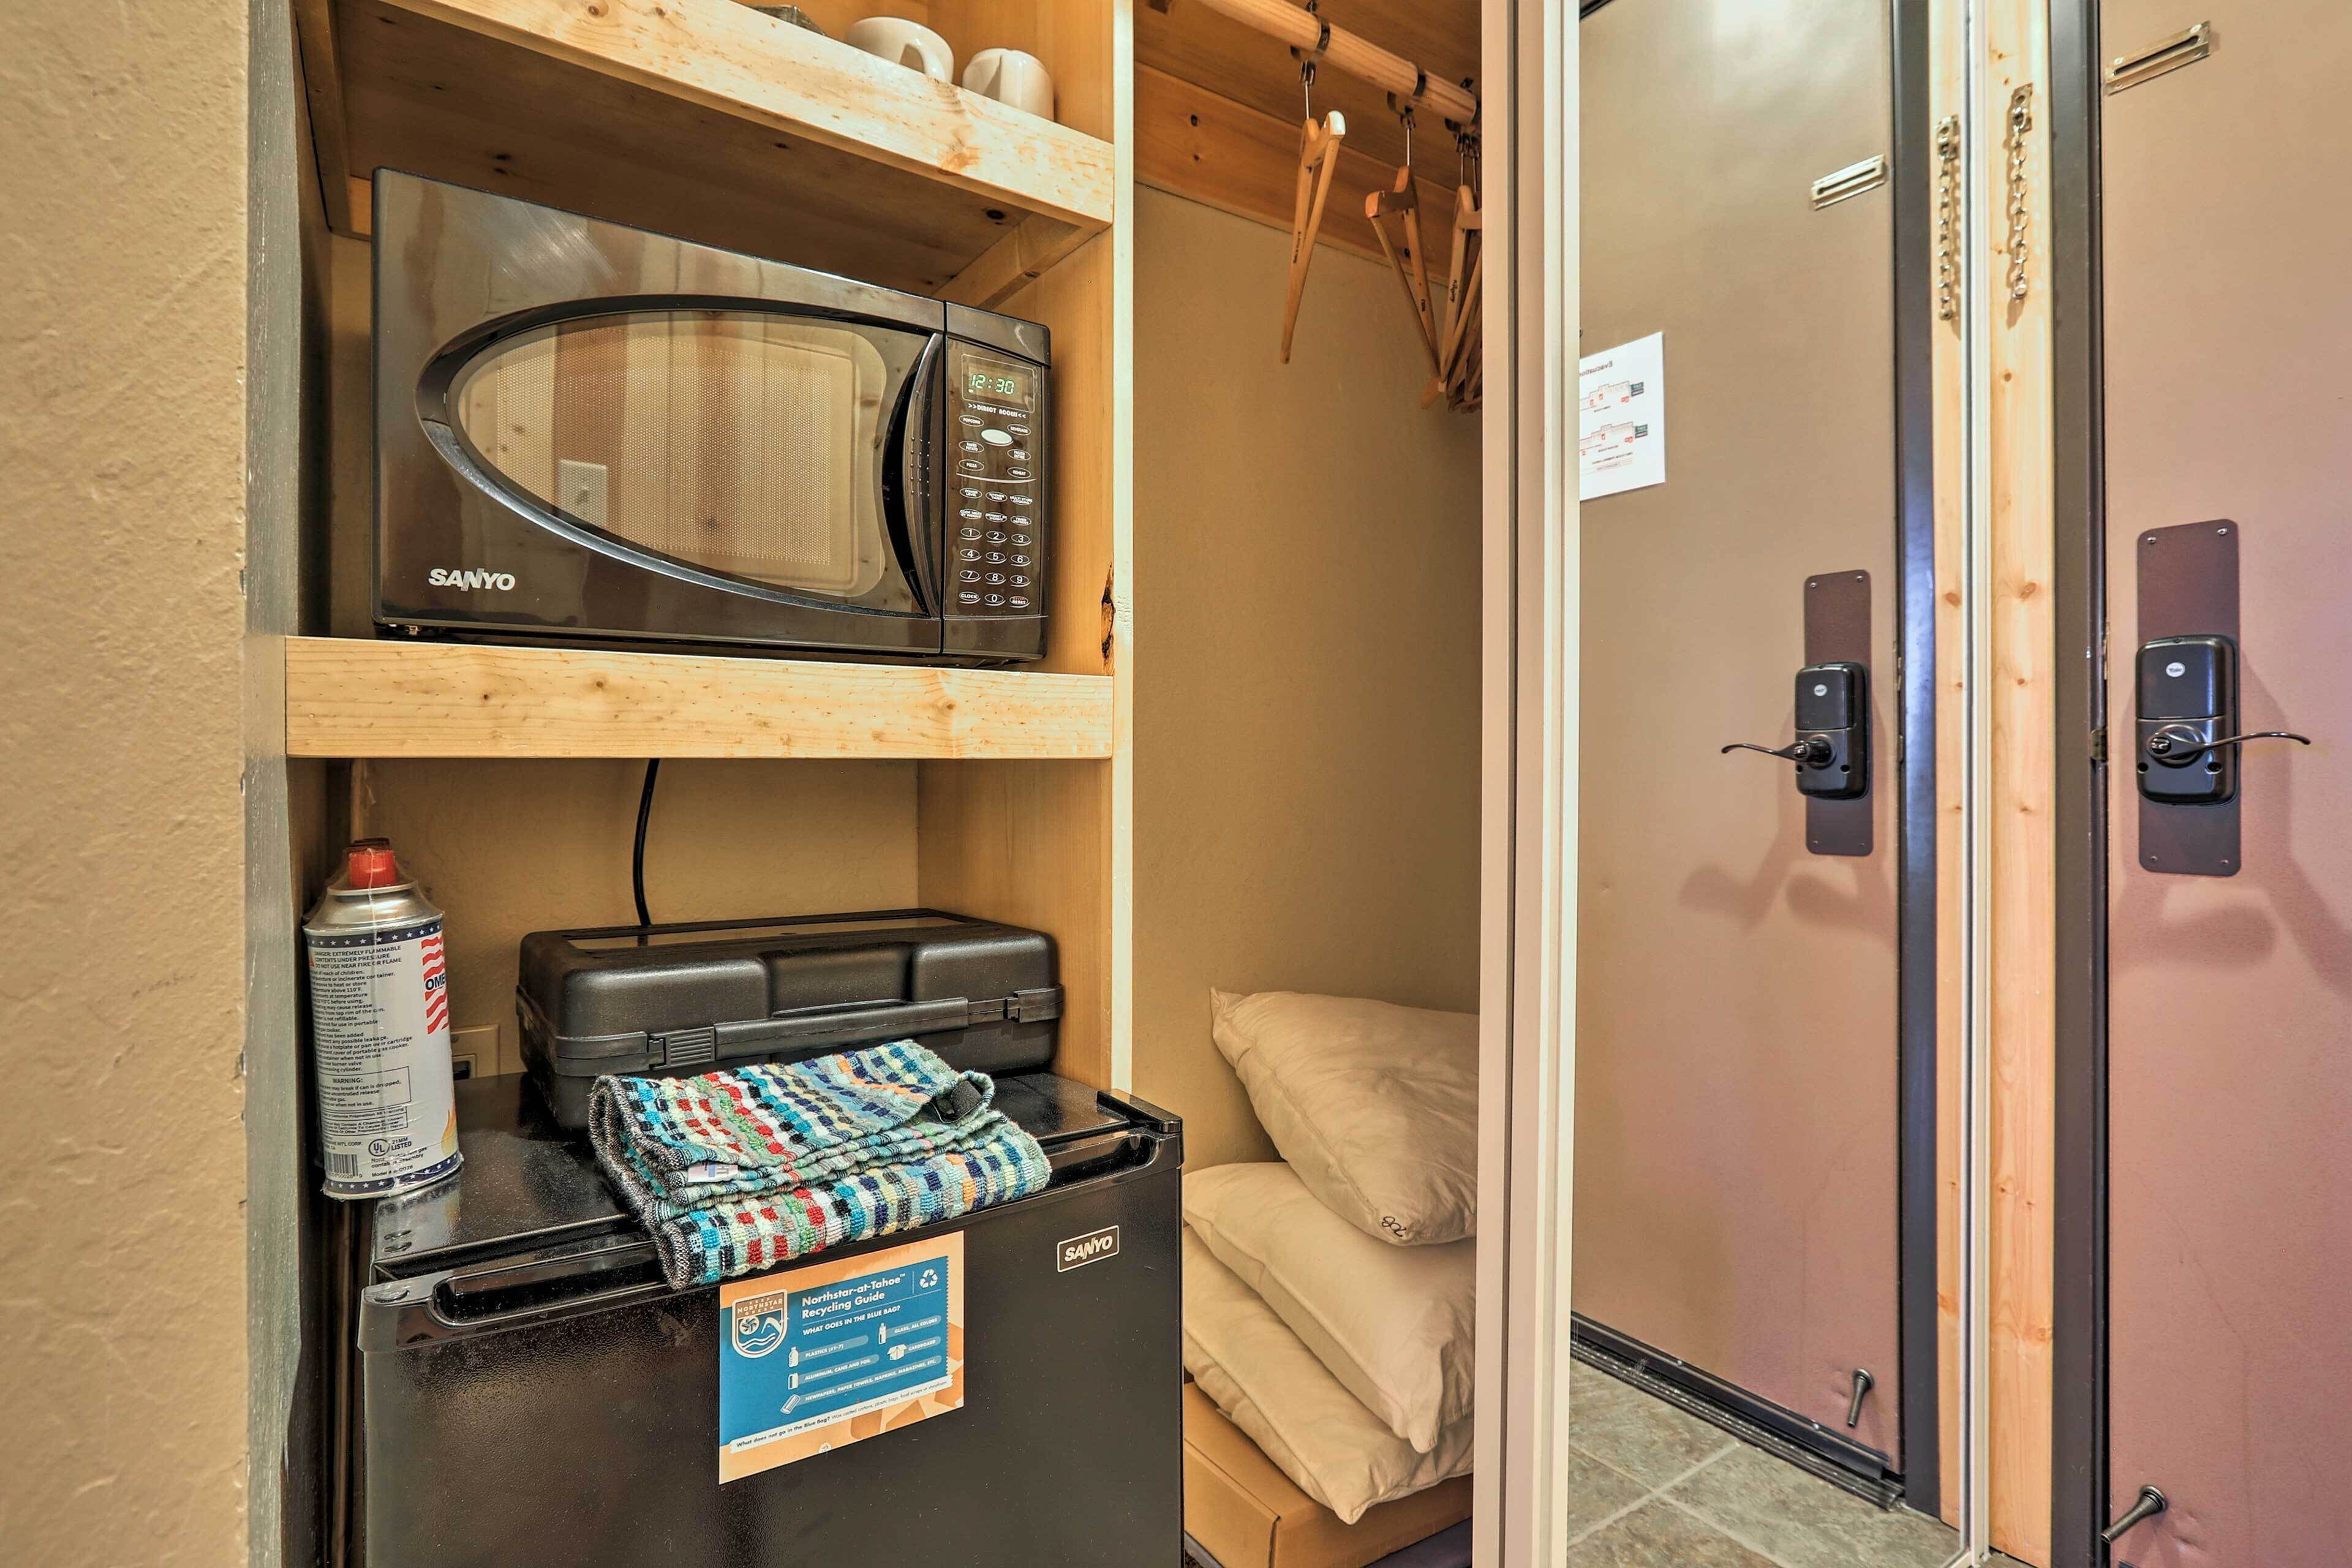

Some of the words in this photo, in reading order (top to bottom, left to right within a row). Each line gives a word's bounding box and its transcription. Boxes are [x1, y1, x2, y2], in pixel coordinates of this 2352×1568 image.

[972, 374, 1014, 394] 12:30
[428, 568, 516, 591] SANYO
[365, 946, 401, 954] FLAMMABLE
[387, 1036, 412, 1046] cartridge
[389, 1042, 409, 1051] cooker.
[391, 1141, 412, 1151] LISTED
[1065, 1235, 1113, 1262] SANYO
[737, 1298, 783, 1314] NORTHSTAR
[802, 1300, 851, 1319] Recycling
[854, 1291, 885, 1305] Guide
[802, 1325, 823, 1335] WHAT
[824, 1321, 843, 1330] GOES
[867, 1310, 883, 1319] BLUE
[884, 1305, 901, 1314] BAG?
[920, 1317, 938, 1327] COLORS
[908, 1340, 936, 1351] CARDBOARD
[805, 1348, 827, 1357] PLASTICS
